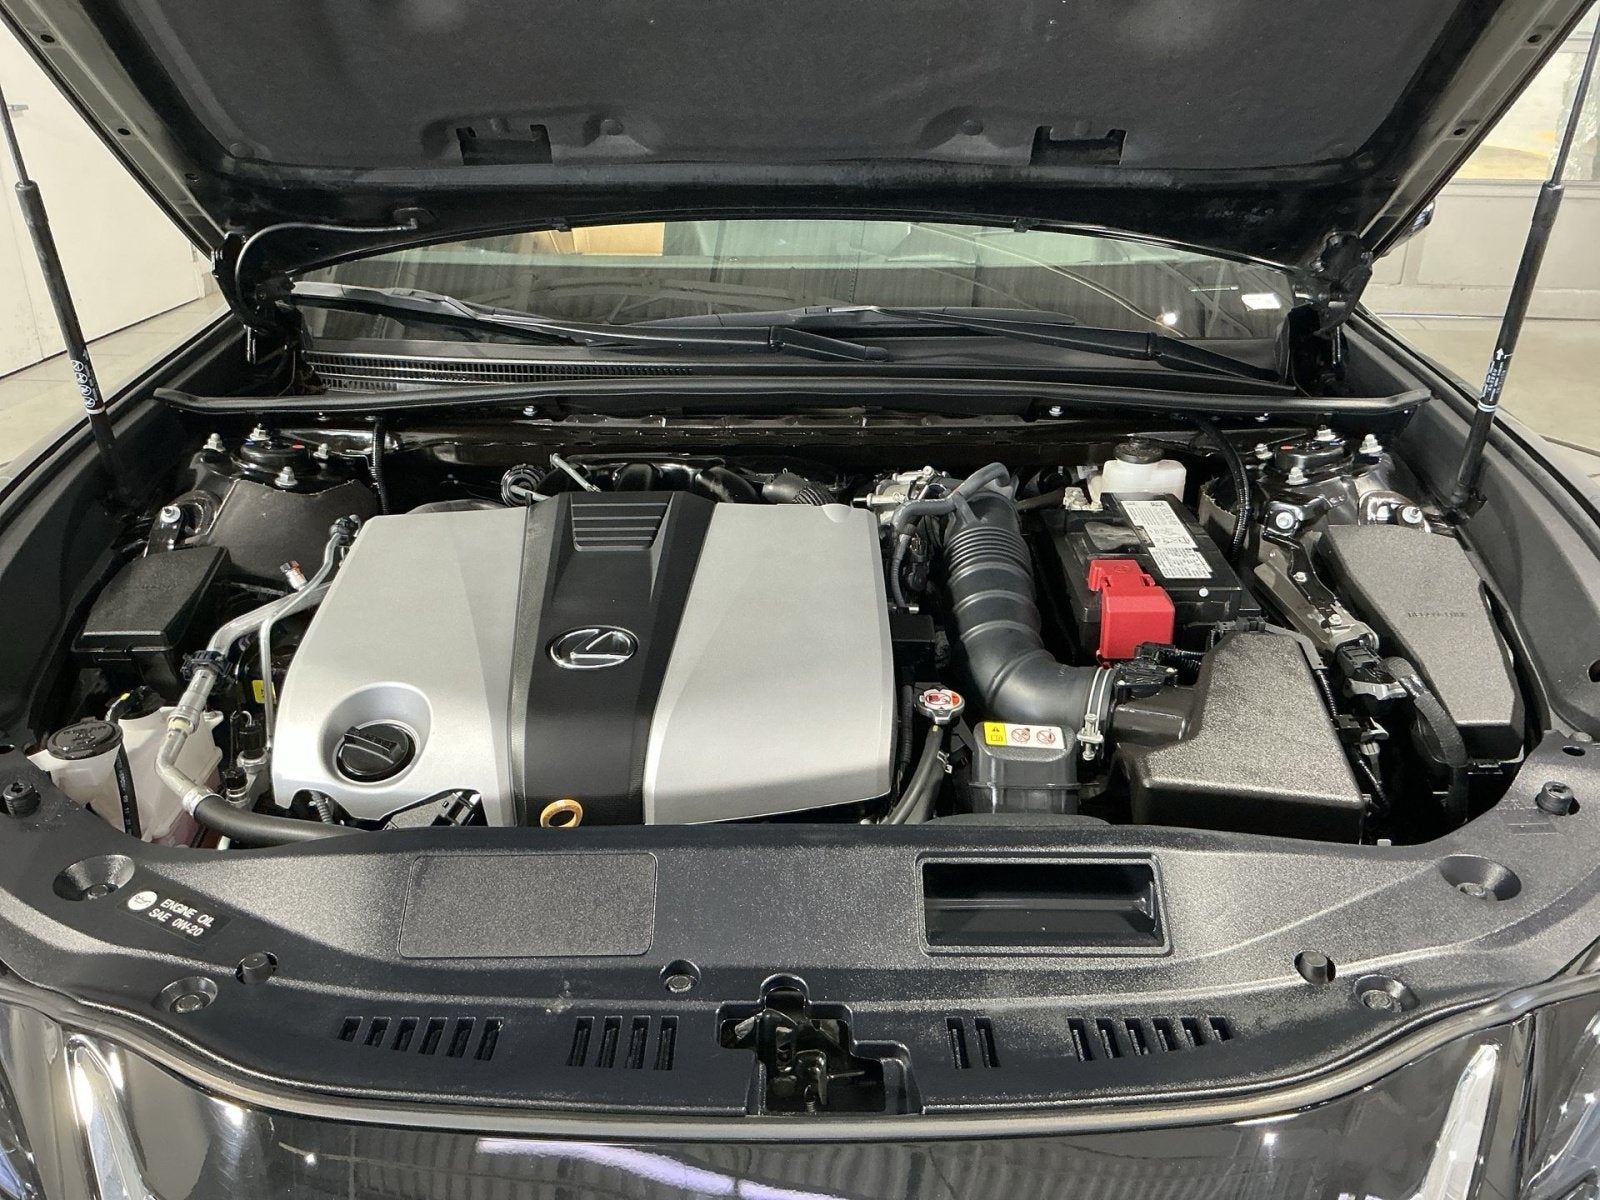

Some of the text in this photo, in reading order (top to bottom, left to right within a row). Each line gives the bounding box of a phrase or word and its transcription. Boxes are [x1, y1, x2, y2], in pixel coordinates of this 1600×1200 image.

[148, 908, 204, 937] SAE 0W-20
[160, 898, 215, 927] ENGINE OIL
